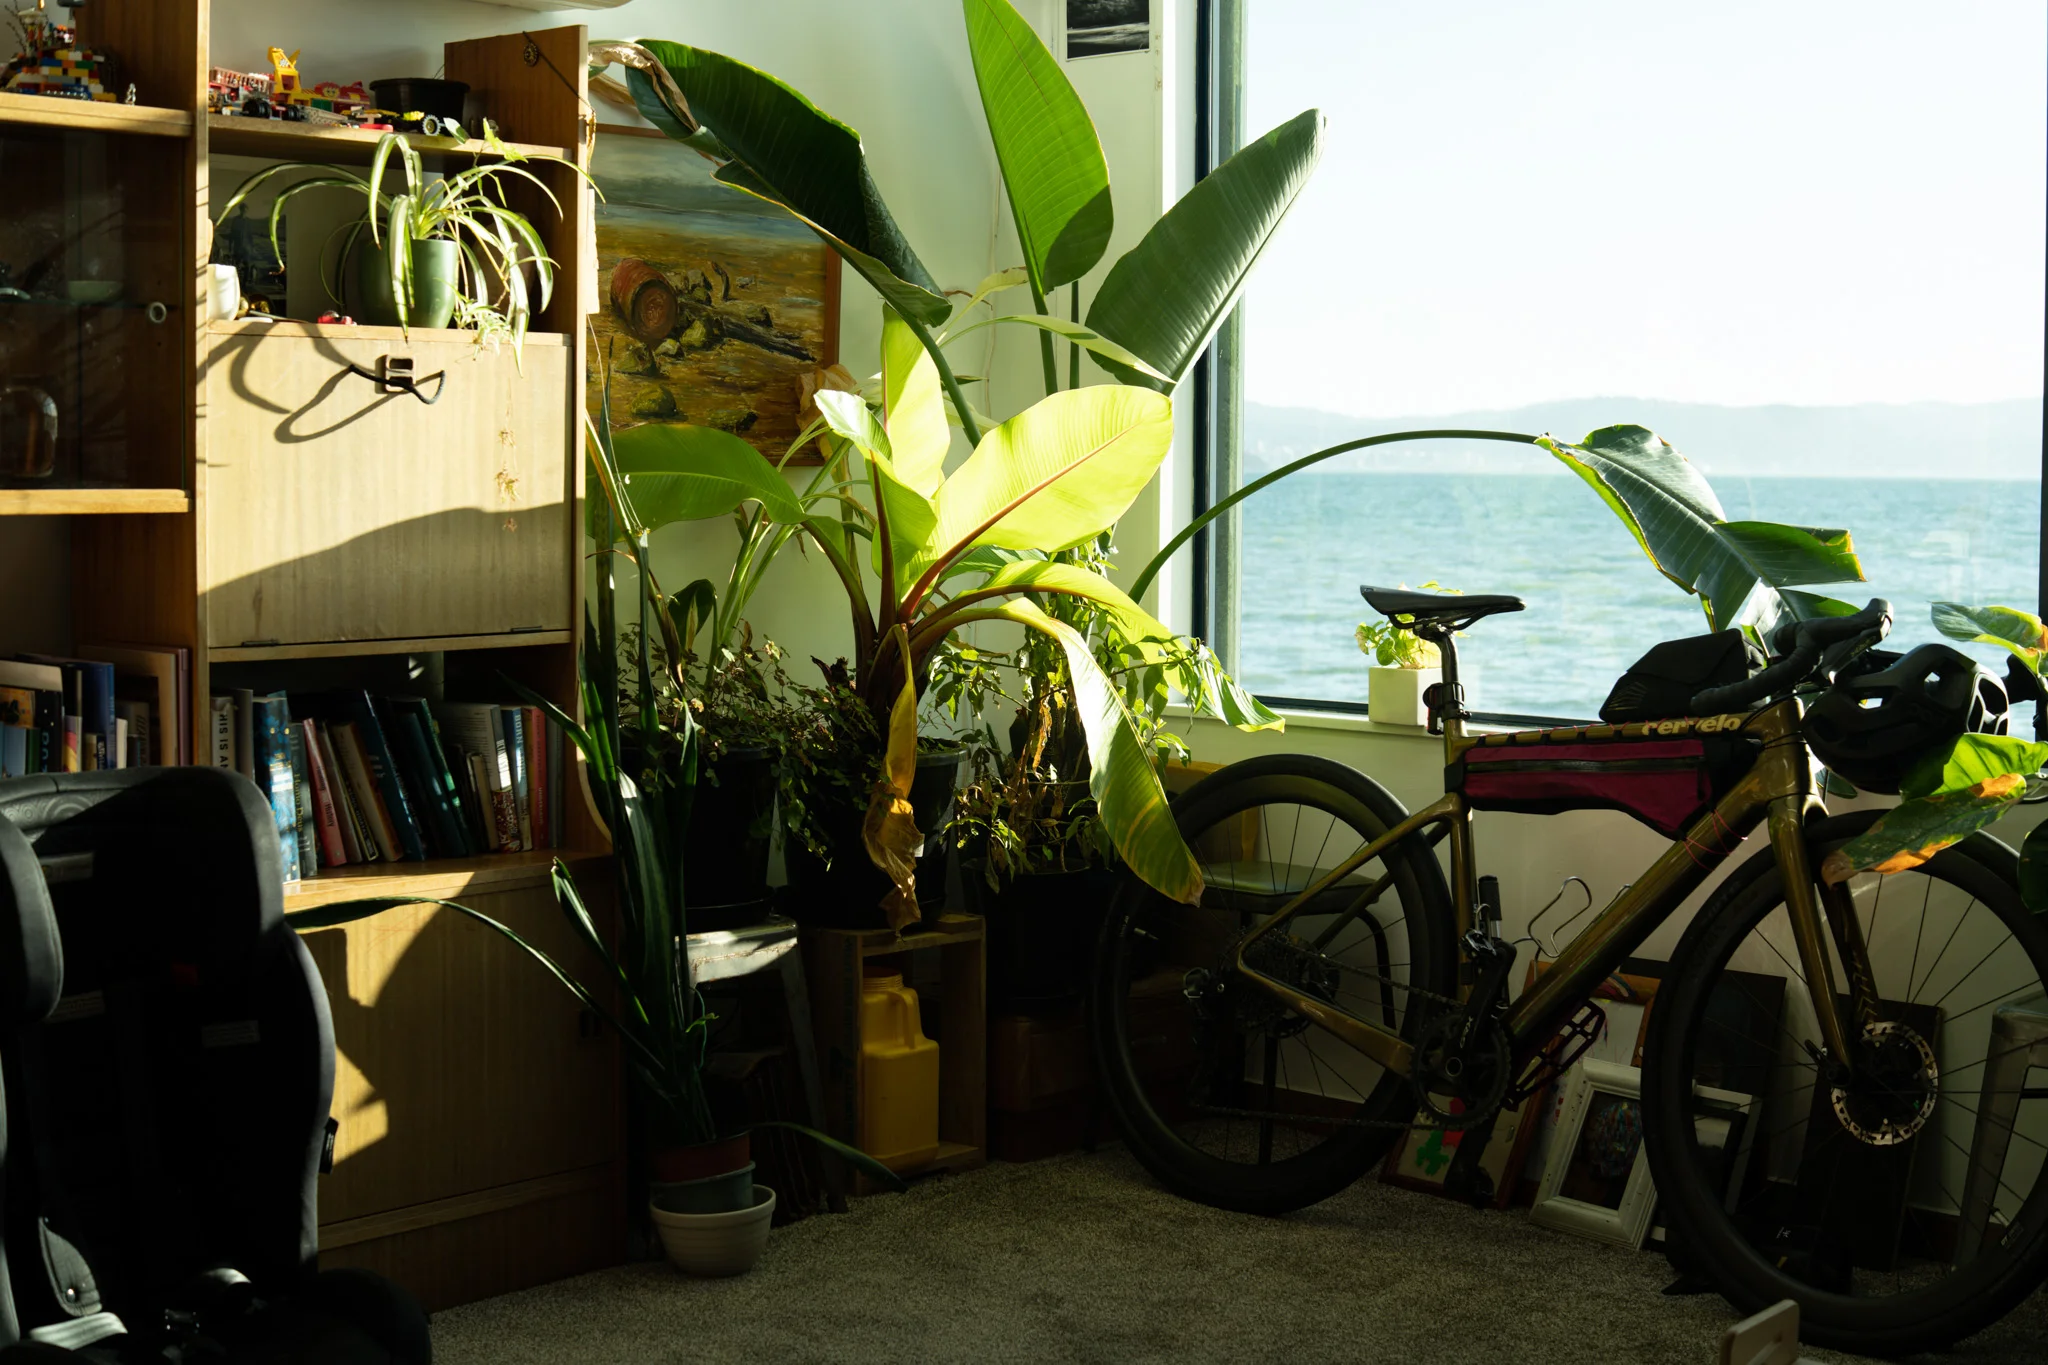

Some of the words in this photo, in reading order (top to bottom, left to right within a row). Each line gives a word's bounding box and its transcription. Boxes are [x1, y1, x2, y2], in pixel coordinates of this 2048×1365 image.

[514, 714, 524, 744] BORN
[219, 738, 229, 751] IS
[293, 773, 302, 805] Homo
[295, 806, 306, 834] Deus
[324, 803, 335, 828] History
